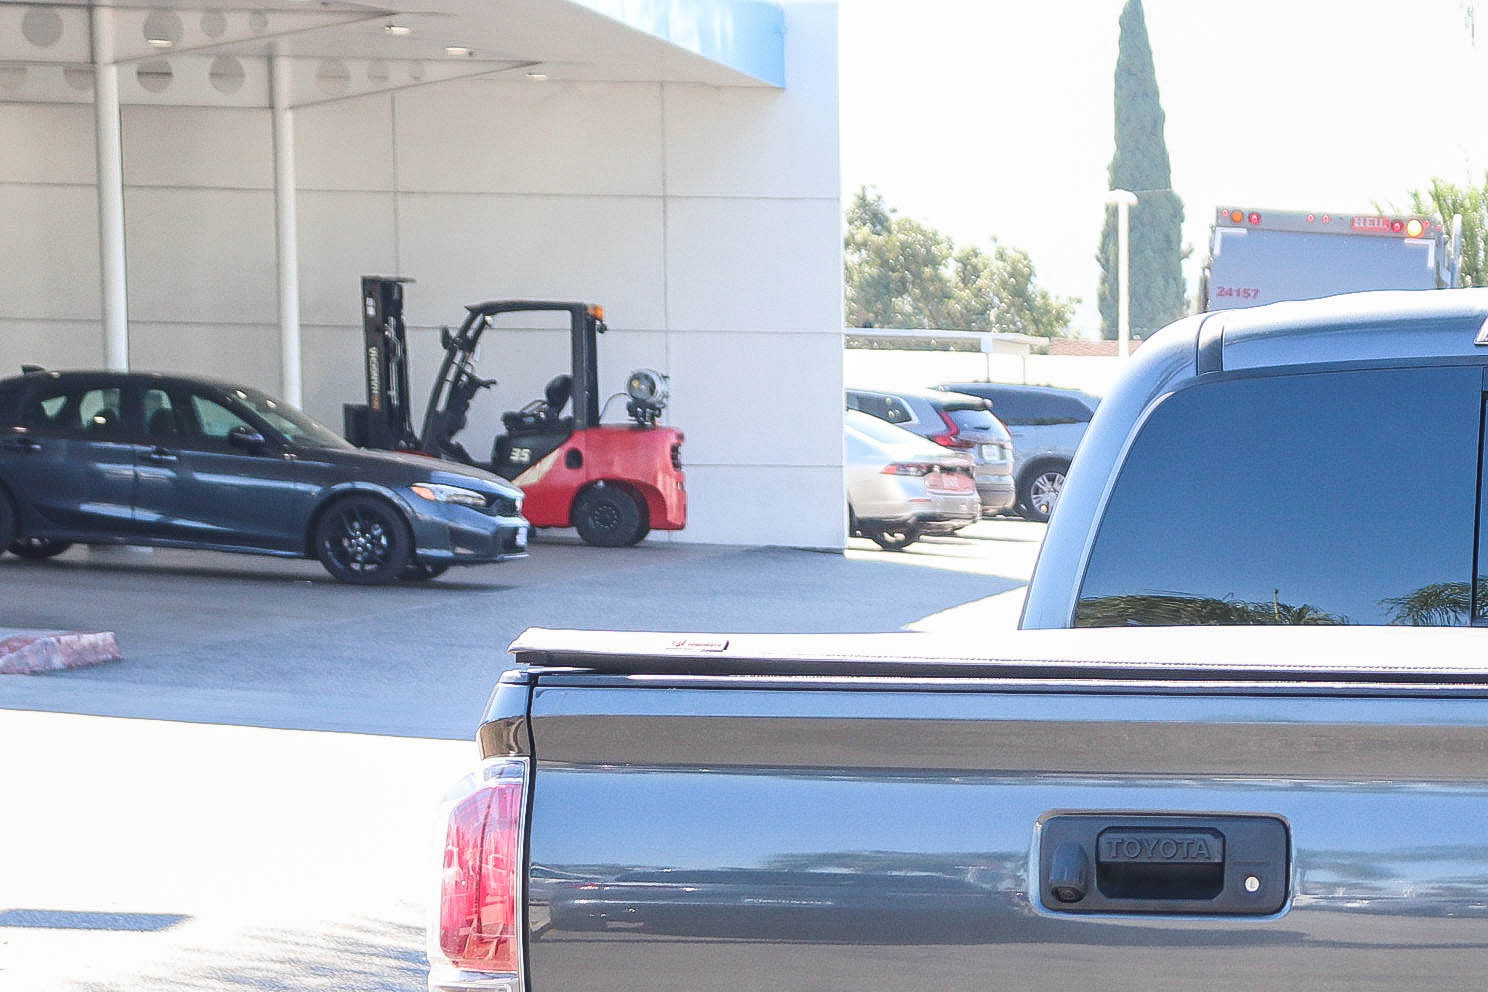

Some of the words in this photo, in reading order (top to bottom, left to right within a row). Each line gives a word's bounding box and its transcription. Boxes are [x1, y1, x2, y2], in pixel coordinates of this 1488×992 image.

[1216, 286, 1260, 299] 24157
[510, 447, 532, 463] 35
[1108, 837, 1211, 861] TOYOTA
